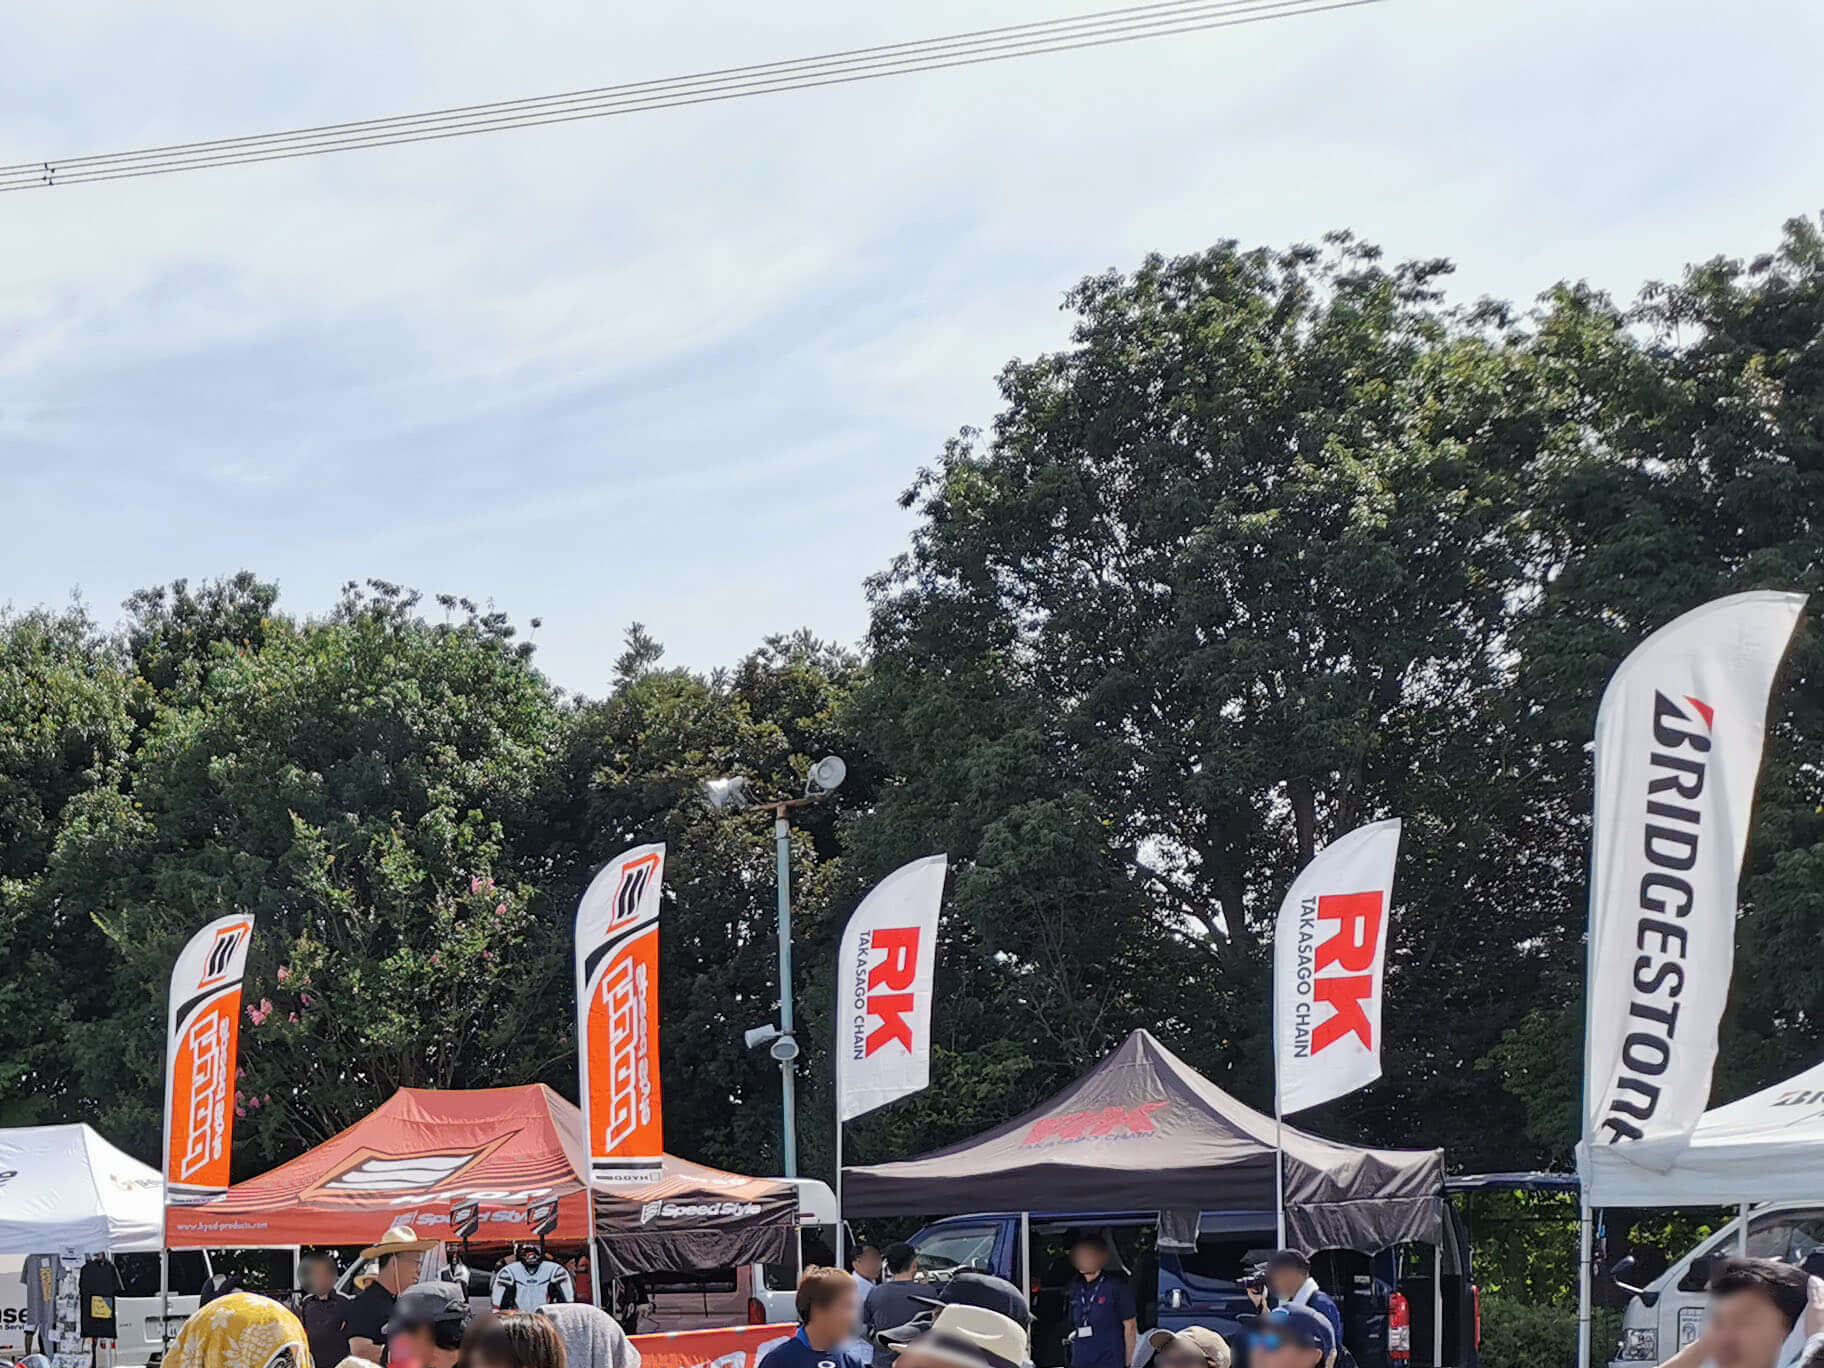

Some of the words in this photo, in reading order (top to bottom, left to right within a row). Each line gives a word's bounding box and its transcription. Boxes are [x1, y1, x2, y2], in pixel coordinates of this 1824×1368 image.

[853, 930, 871, 1010] TAKASAGO
[1296, 896, 1317, 996] TAKASAGO
[1310, 890, 1384, 1056] RK
[865, 926, 921, 1058] RK
[1293, 1001, 1311, 1058] CHAIN
[852, 1014, 866, 1061] CHAIN
